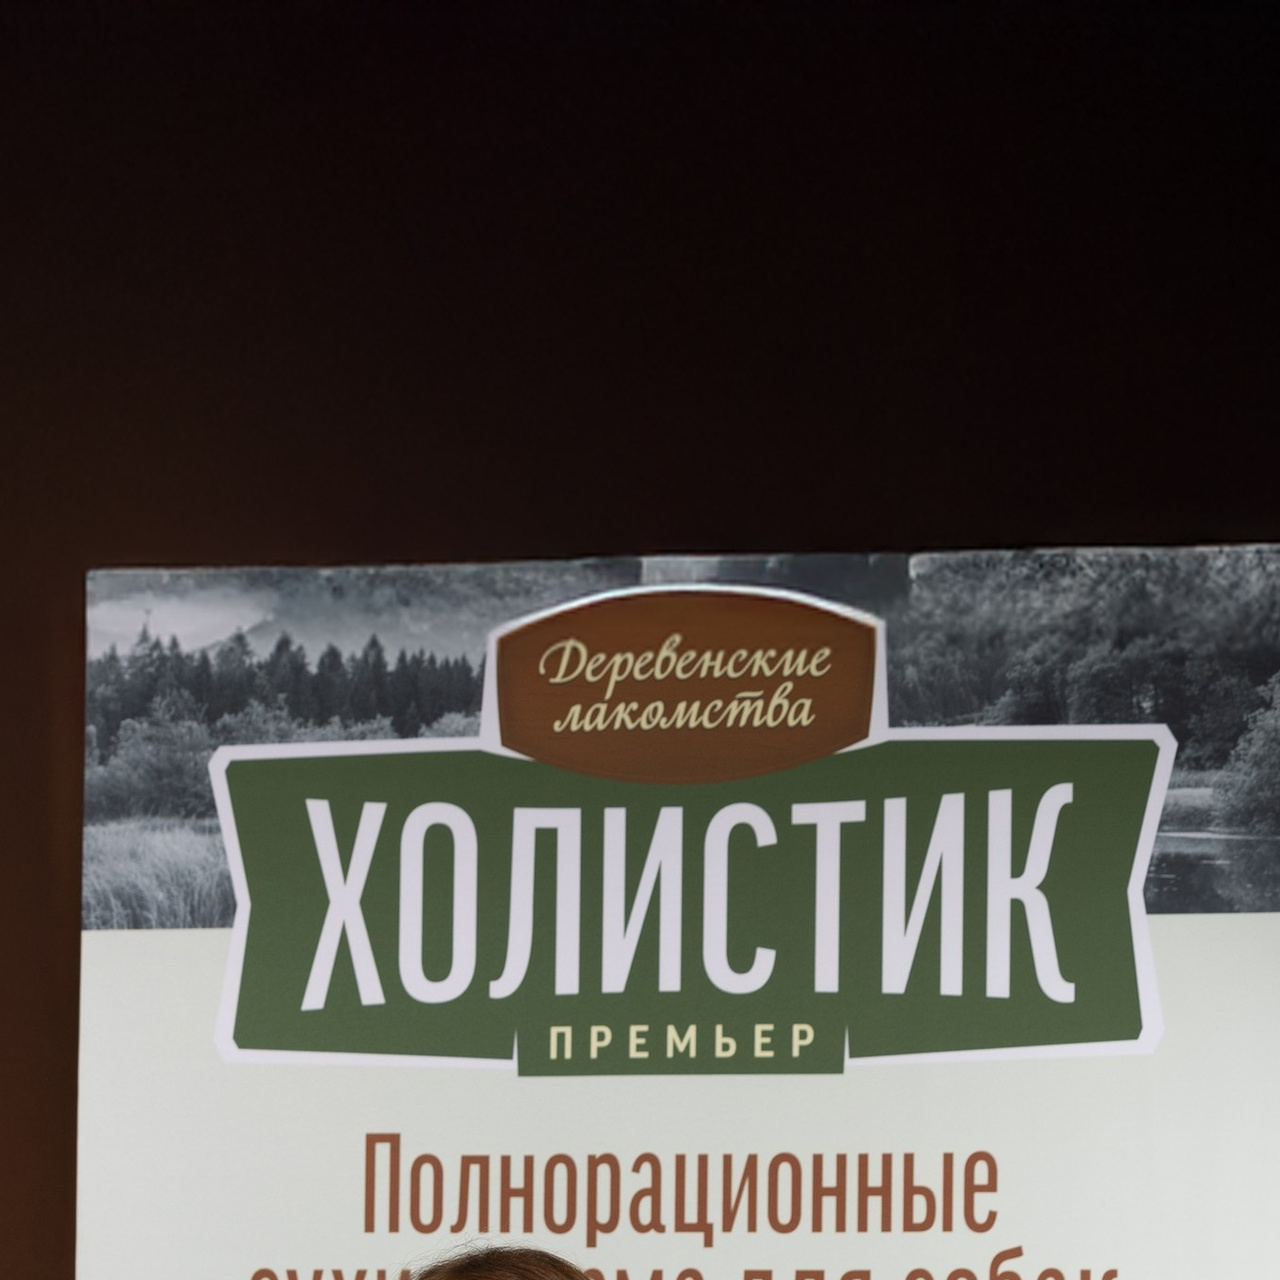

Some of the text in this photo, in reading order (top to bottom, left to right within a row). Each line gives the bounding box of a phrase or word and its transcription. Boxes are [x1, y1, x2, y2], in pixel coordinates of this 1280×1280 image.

[538, 634, 833, 700] Деревенские
[552, 682, 818, 735] лакомства
[301, 783, 1078, 1013] ХОЛИСТИК
[549, 1023, 817, 1060] ПРЕМЬЕР
[363, 1132, 1000, 1249] Полнорационные
